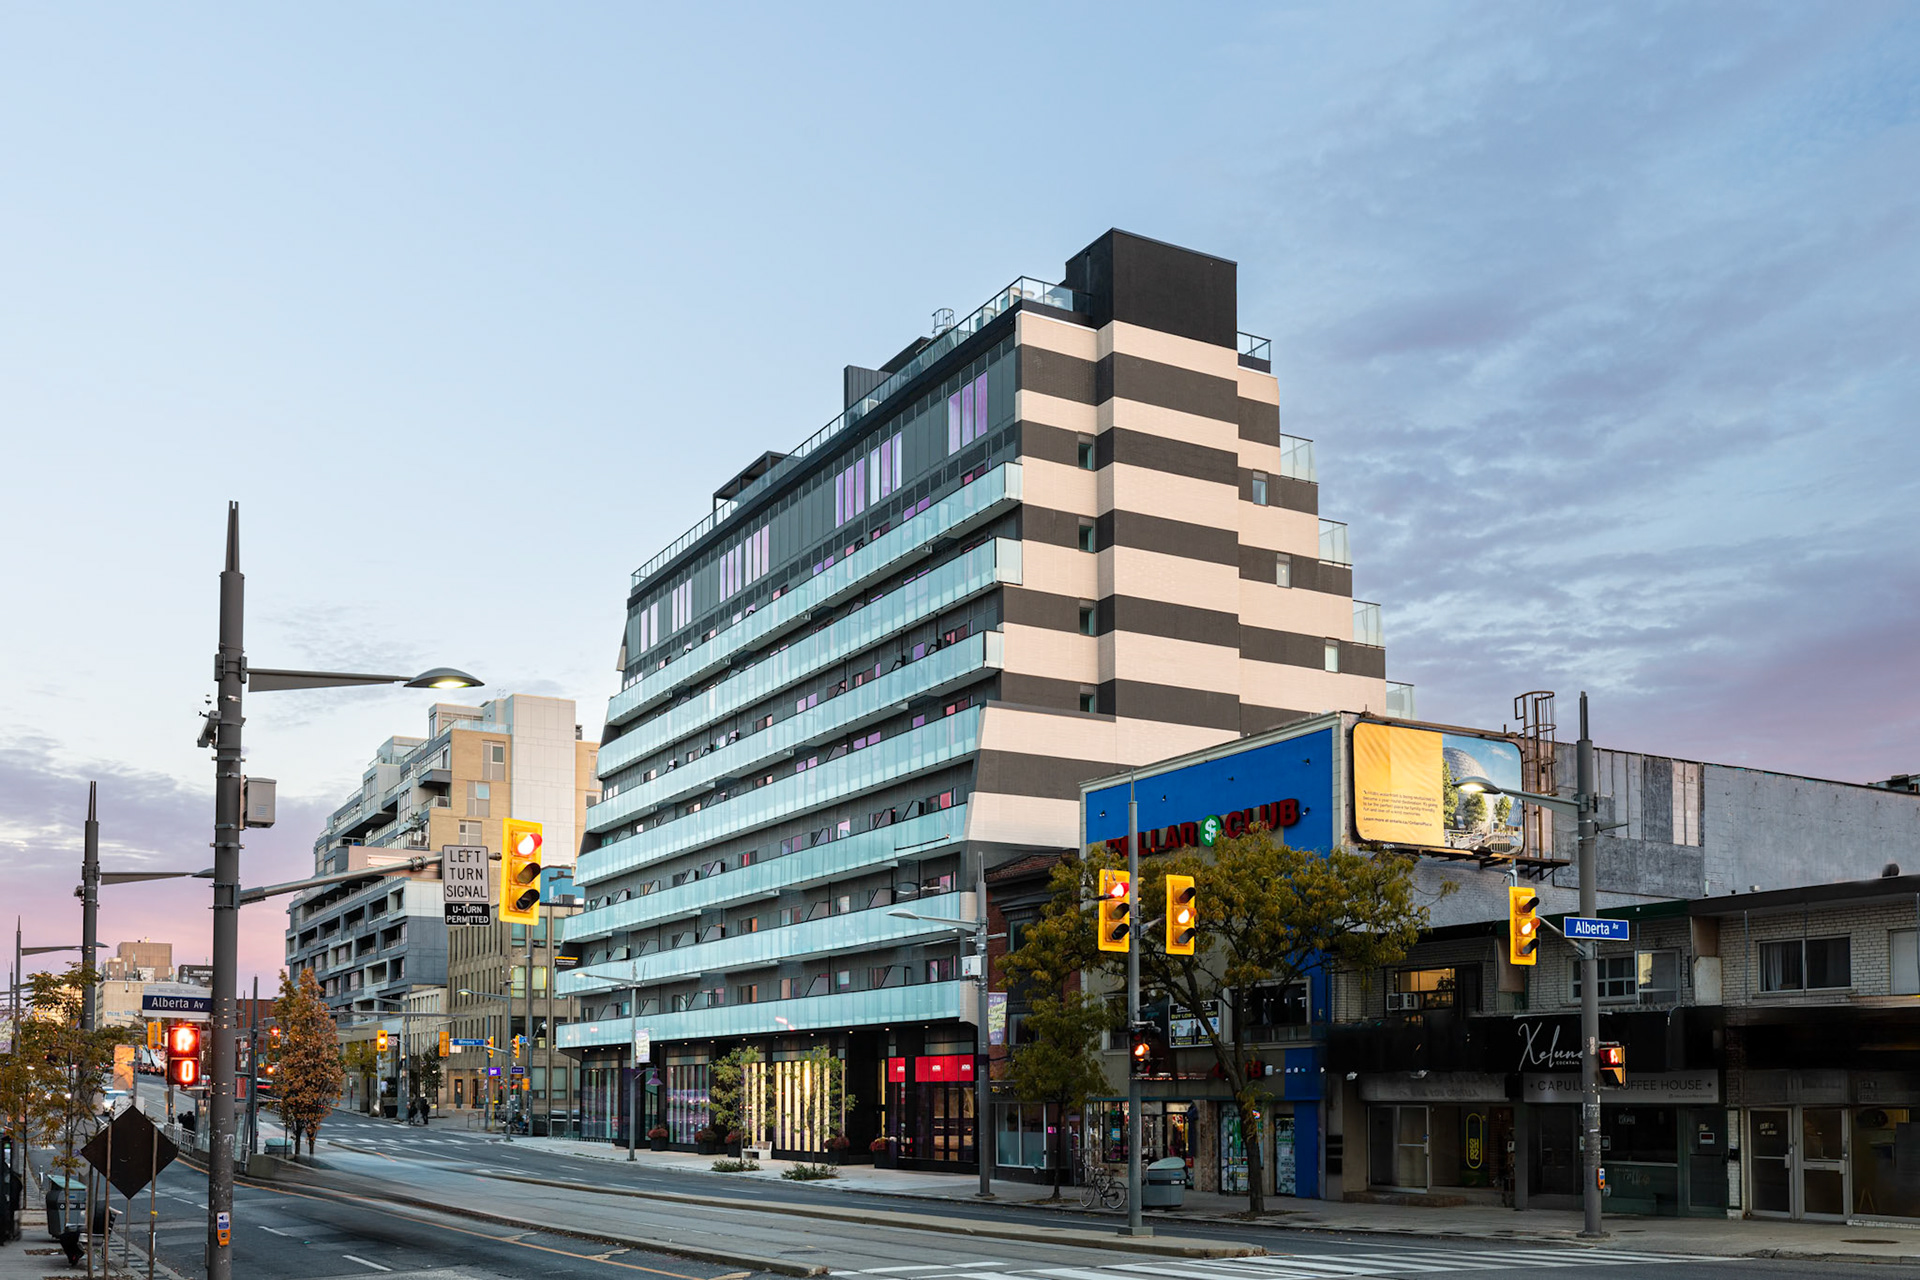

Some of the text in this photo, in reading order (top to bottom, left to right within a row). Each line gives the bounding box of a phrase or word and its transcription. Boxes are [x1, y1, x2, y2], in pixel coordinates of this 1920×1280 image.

[1225, 798, 1299, 839] CLUB
[450, 850, 480, 863] LEFT
[449, 867, 483, 880] TURN
[446, 885, 487, 898] SIGNAL
[452, 906, 483, 914] U-TURN
[446, 915, 489, 924] PERMITTED
[1575, 921, 1610, 935] Alberta
[152, 996, 204, 1008] Alberta Av
[181, 1060, 194, 1082] 0
[1618, 1080, 1657, 1090] OFFEE
[1660, 1079, 1702, 1090] HOUSE
